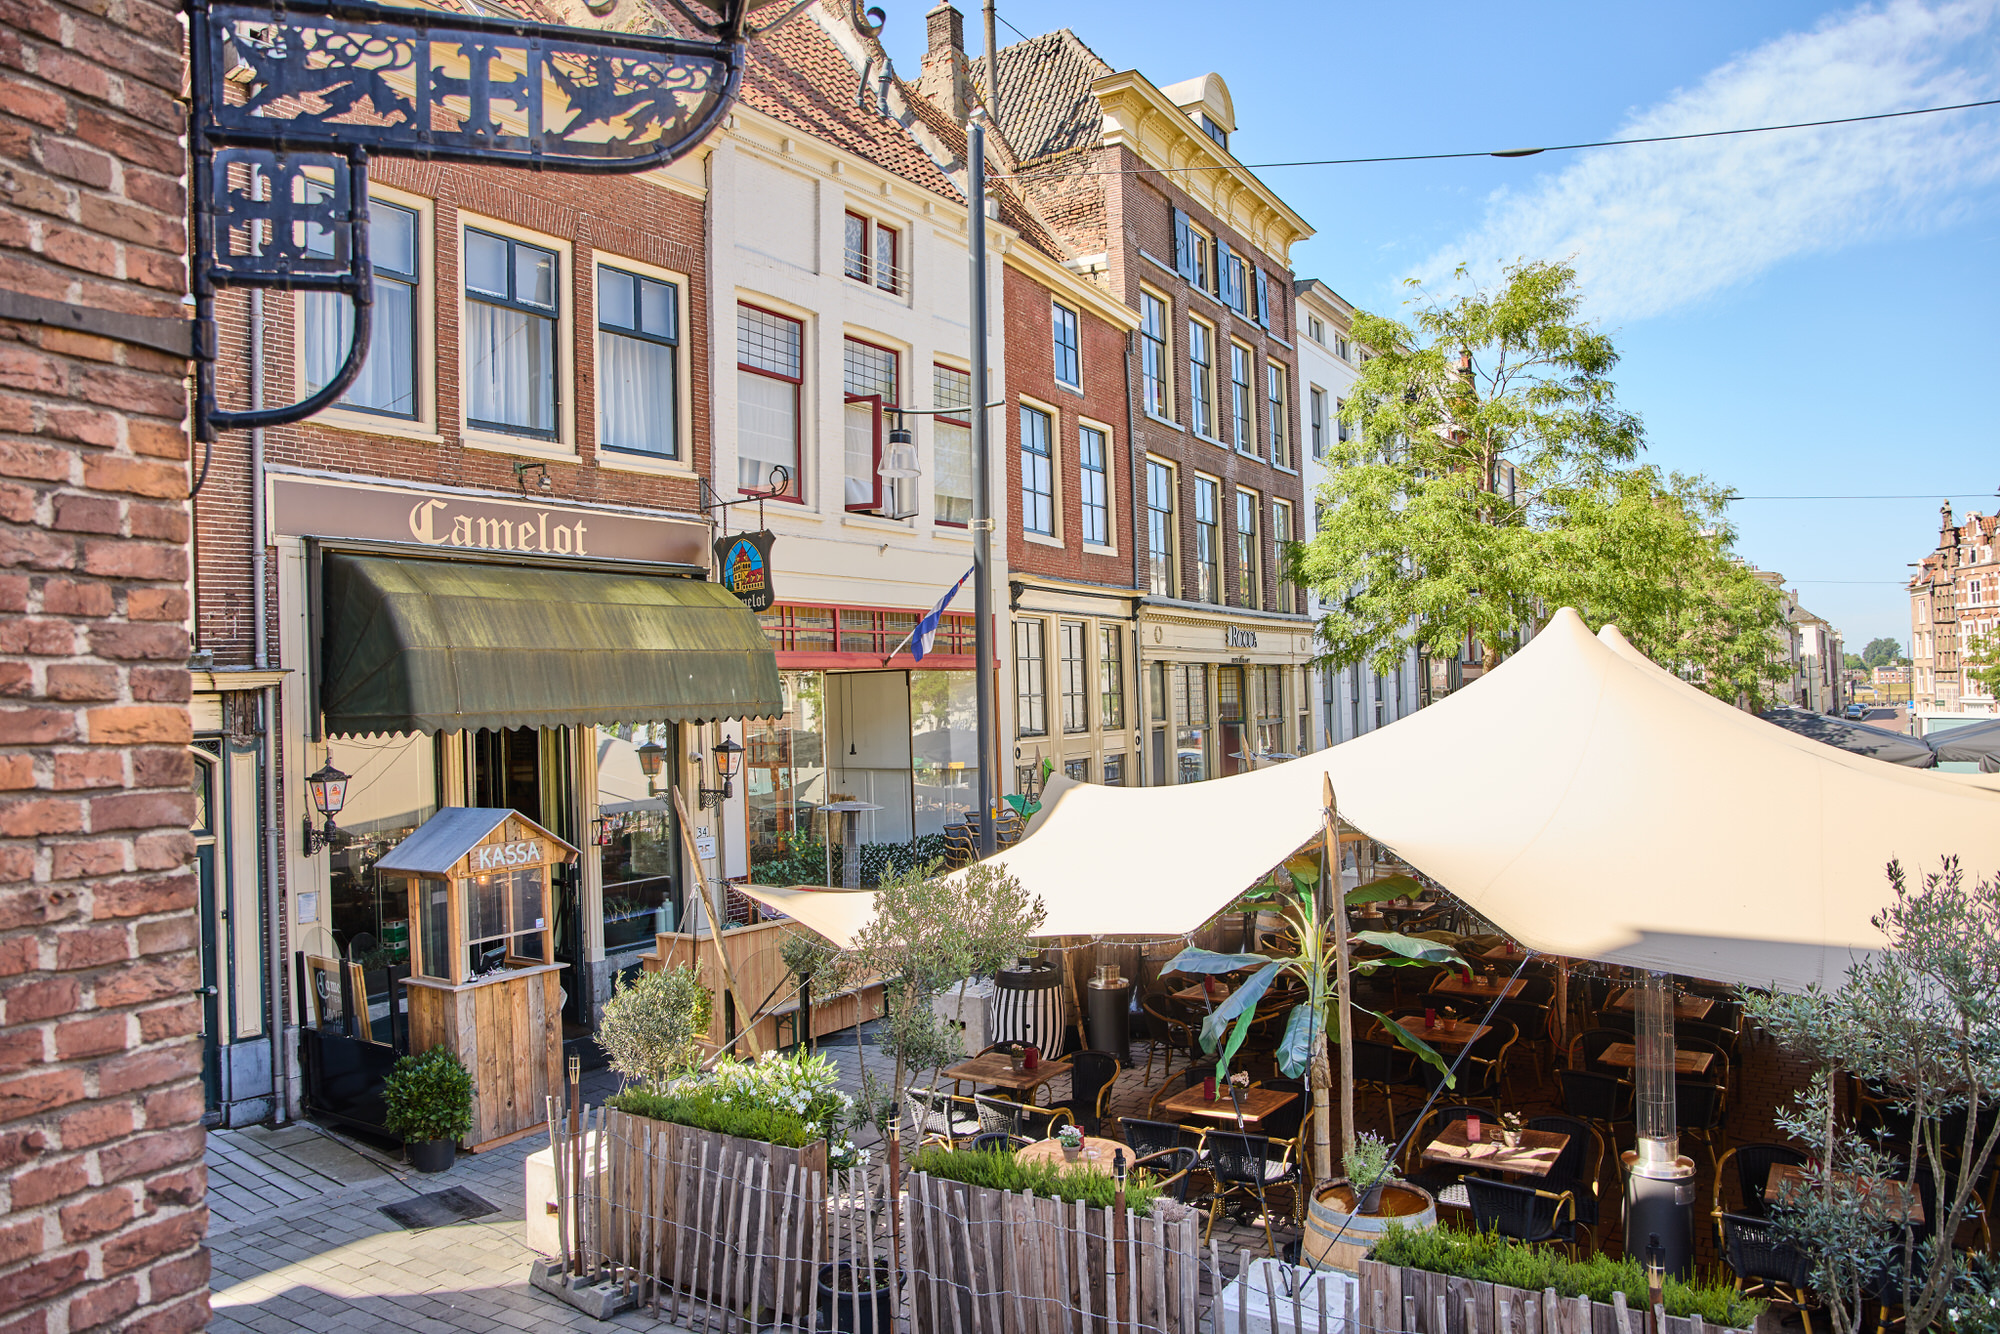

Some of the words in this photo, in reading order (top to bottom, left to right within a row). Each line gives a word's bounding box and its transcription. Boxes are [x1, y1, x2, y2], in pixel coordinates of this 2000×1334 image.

[409, 498, 588, 556] Camelot
[697, 827, 707, 838] 34
[479, 841, 540, 869] KASSA
[316, 970, 341, 999] Came
